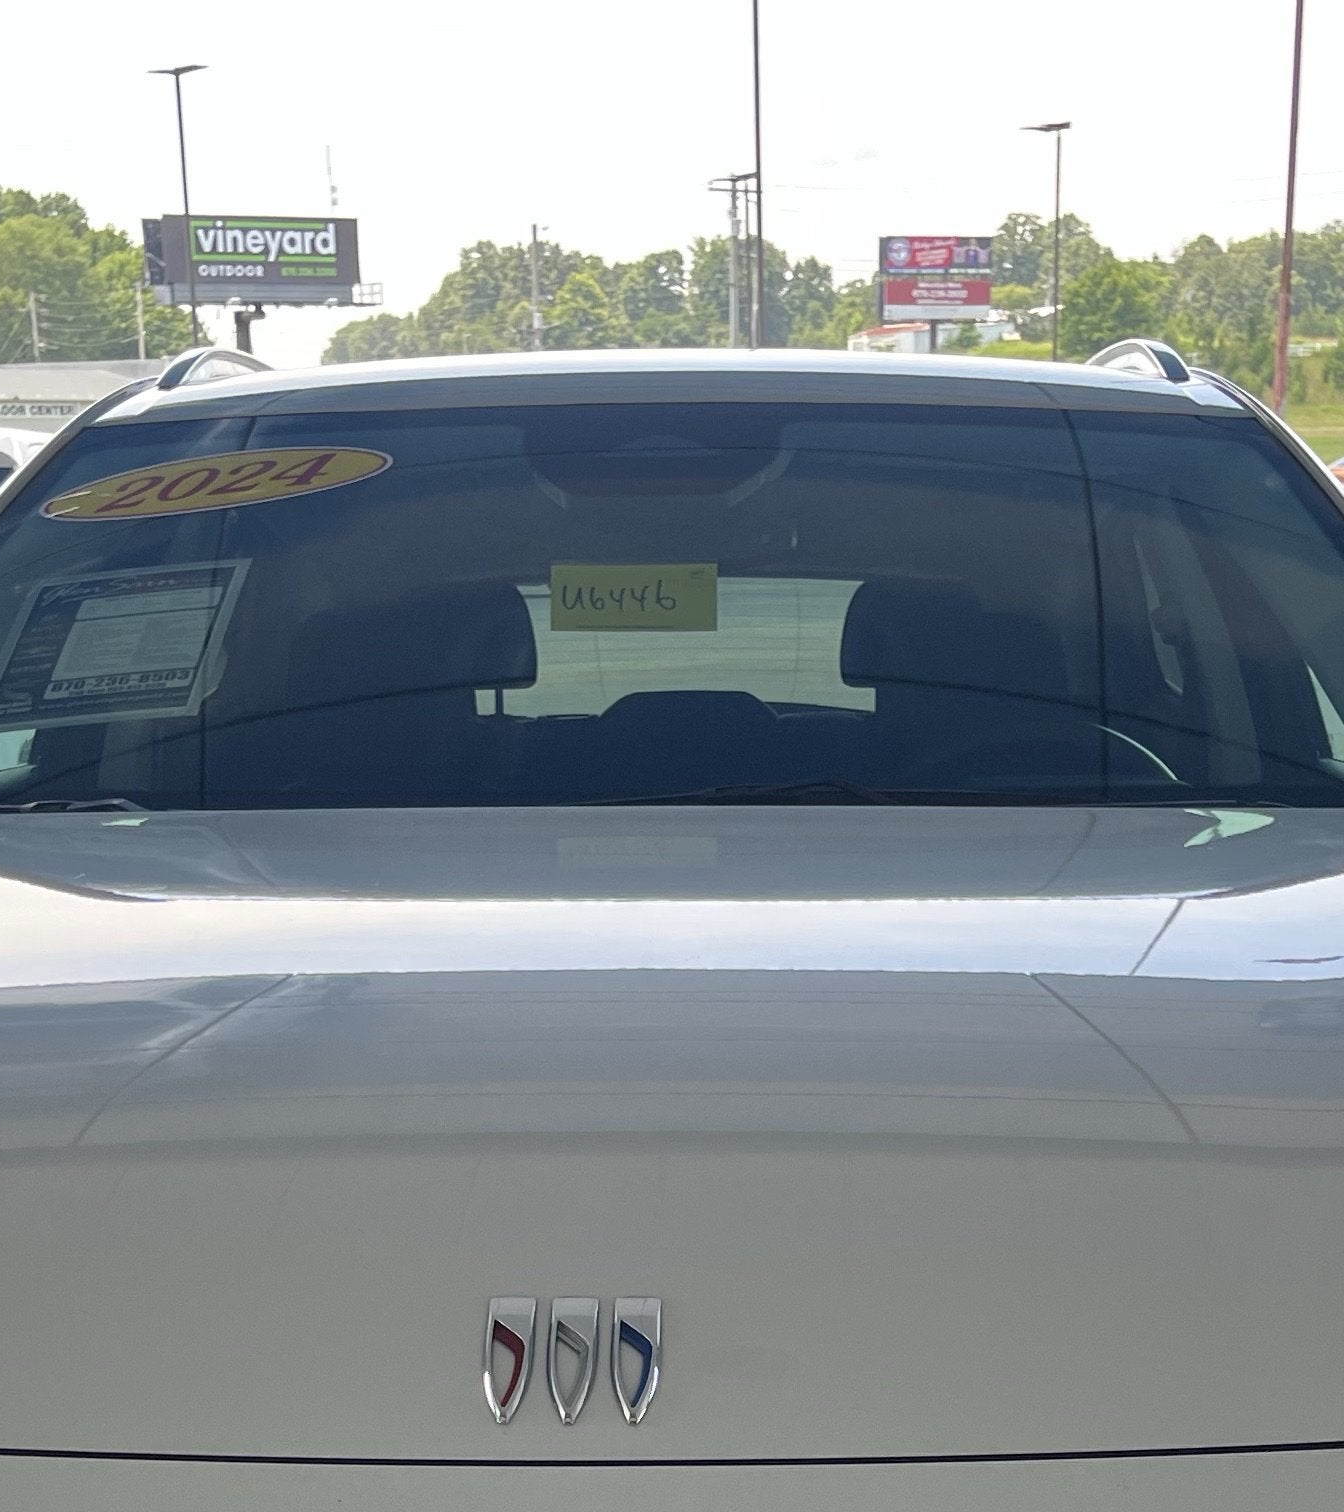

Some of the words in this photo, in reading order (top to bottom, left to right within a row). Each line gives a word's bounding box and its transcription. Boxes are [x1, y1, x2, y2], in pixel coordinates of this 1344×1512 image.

[196, 220, 337, 262] vineyard
[198, 264, 265, 277] OUTDOOR
[30, 405, 76, 416] CENTER
[96, 452, 338, 514] 2024
[561, 579, 677, 612] U6446
